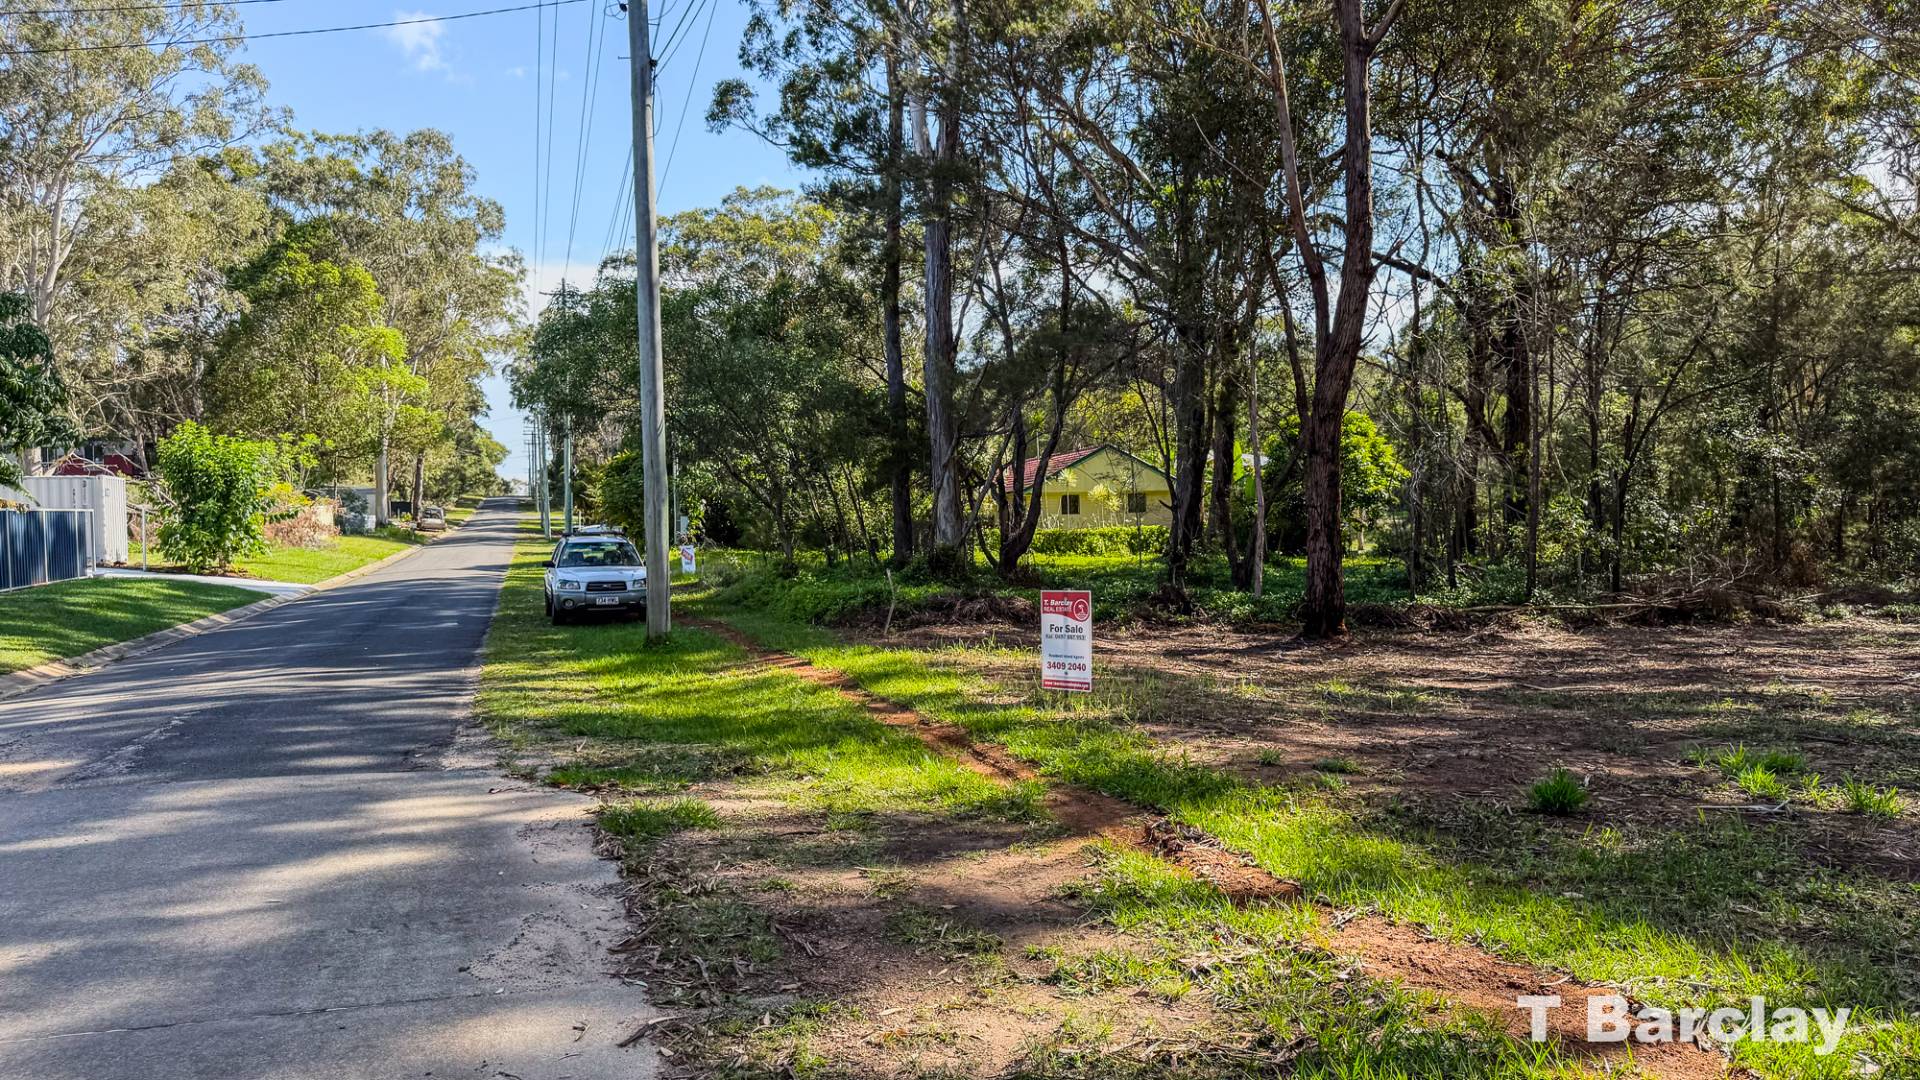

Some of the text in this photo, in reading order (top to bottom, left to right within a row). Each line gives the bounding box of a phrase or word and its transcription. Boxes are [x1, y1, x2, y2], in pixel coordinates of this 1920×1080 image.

[1050, 599, 1073, 607] Barclay
[1050, 624, 1083, 634] For Sale
[1047, 661, 1087, 672] 3409 2040
